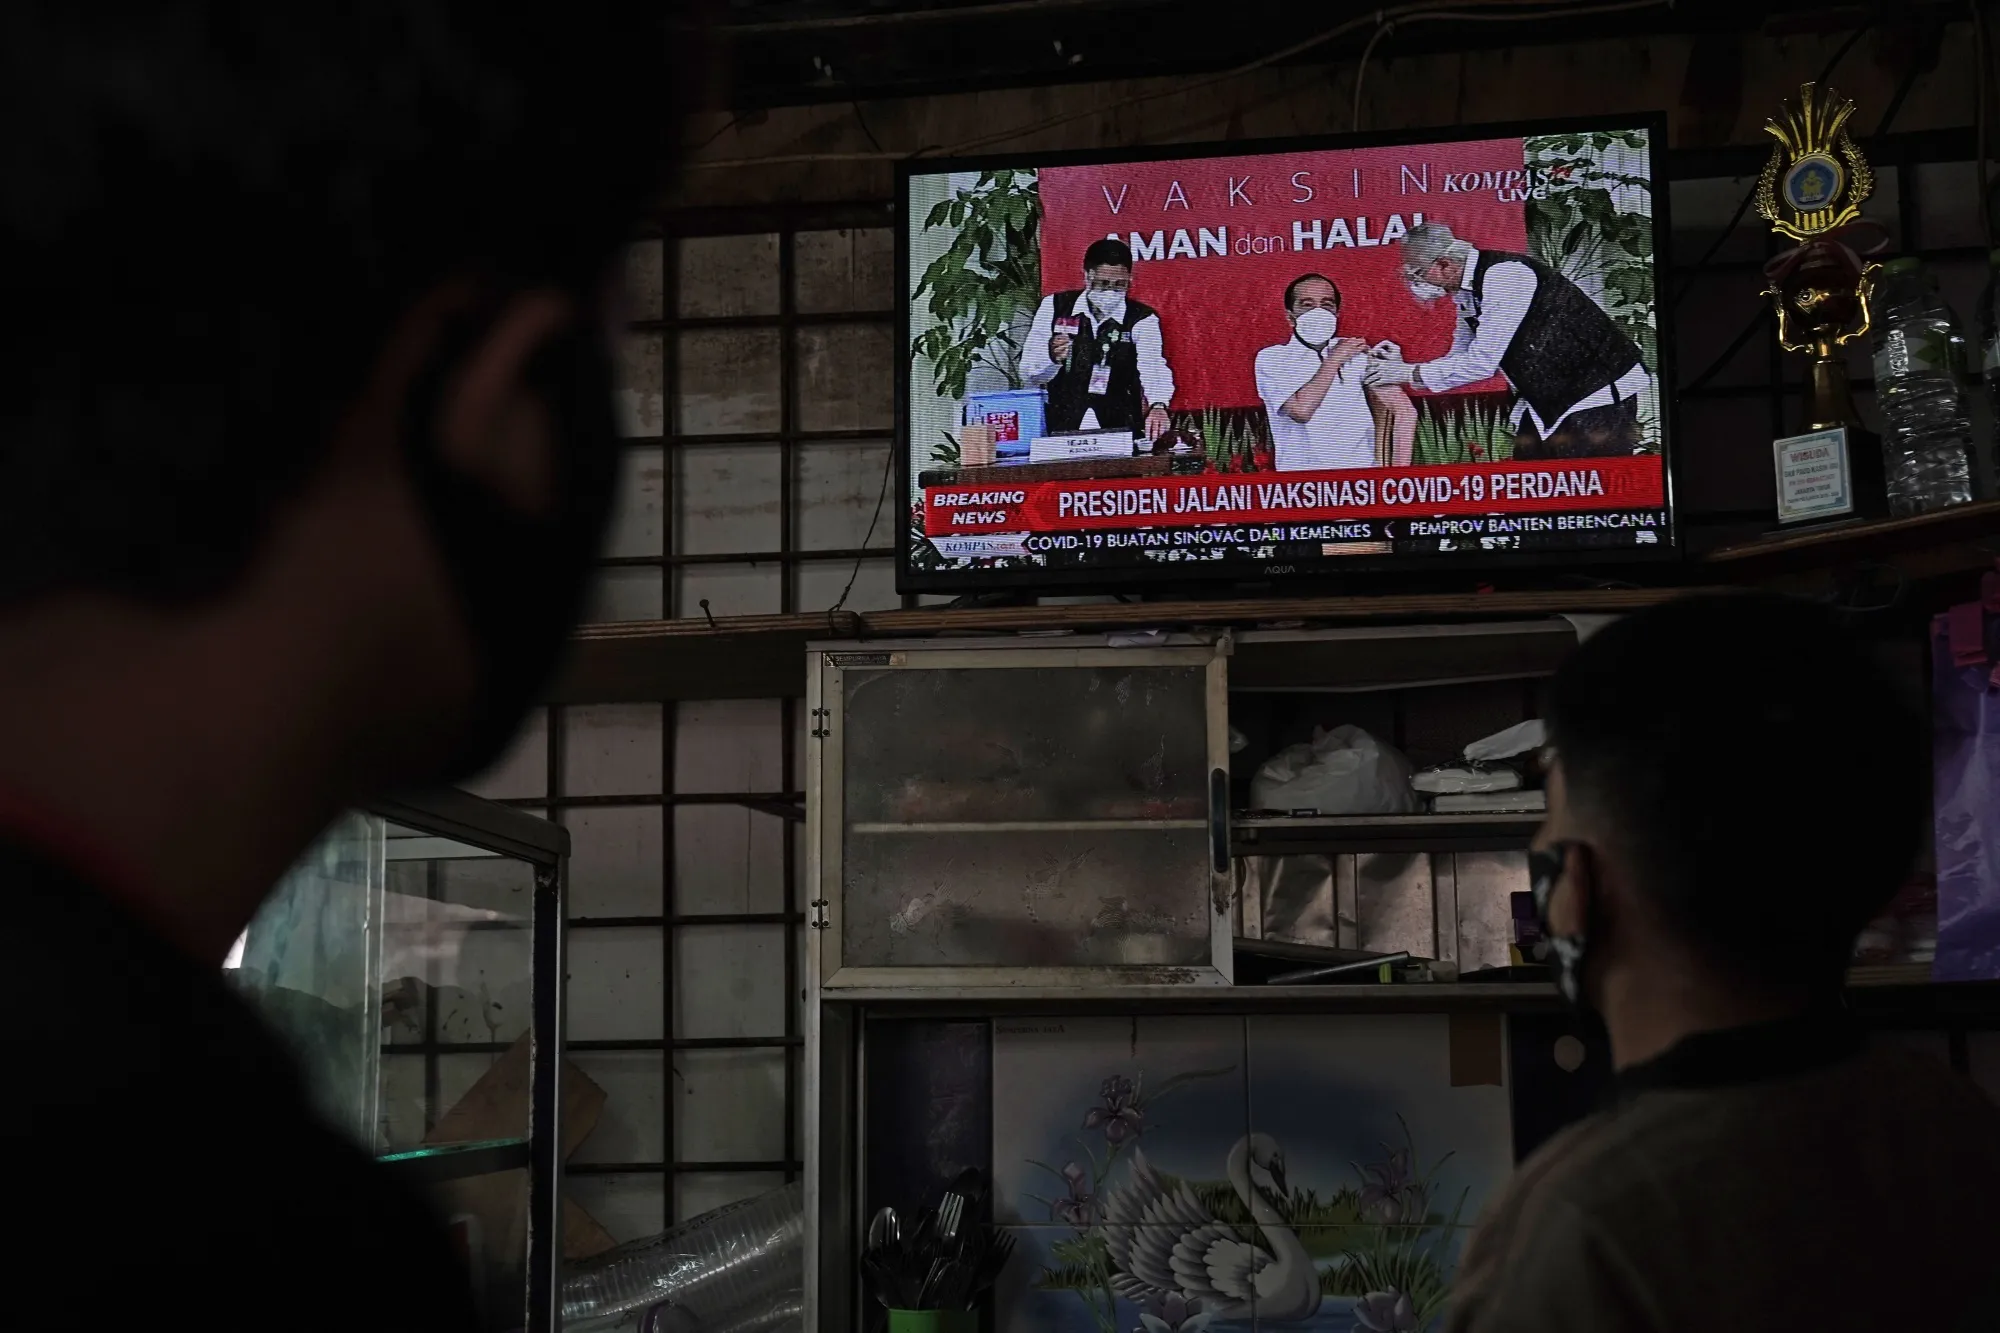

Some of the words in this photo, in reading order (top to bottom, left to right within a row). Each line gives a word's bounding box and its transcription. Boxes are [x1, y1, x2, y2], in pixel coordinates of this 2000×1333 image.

[1102, 163, 1430, 214] VAKSIN
[1443, 168, 1549, 193] KOMPAS
[1104, 225, 1229, 262] MAN
[1234, 232, 1285, 256] dan
[989, 411, 1015, 421] STOP
[934, 490, 1025, 507] BREAKING
[1059, 488, 1167, 517] PRESIDEN
[1174, 484, 1251, 513] JALANI
[1257, 479, 1375, 509] VAKSINASI
[1382, 475, 1484, 505] COVID-19
[1491, 470, 1604, 499] PERDANA
[952, 510, 1006, 525] NEWS
[1027, 534, 1103, 550] COVID-19
[1108, 533, 1169, 547] BUATAN
[1174, 528, 1244, 544] SINOVAC
[1250, 527, 1285, 542] DARI
[1290, 524, 1371, 540] KEMENKES
[1410, 519, 1484, 536] PEMPROV
[1489, 517, 1552, 533] BANTEN
[1558, 514, 1656, 530] BERENCANA
[1264, 566, 1296, 574] AQUA
